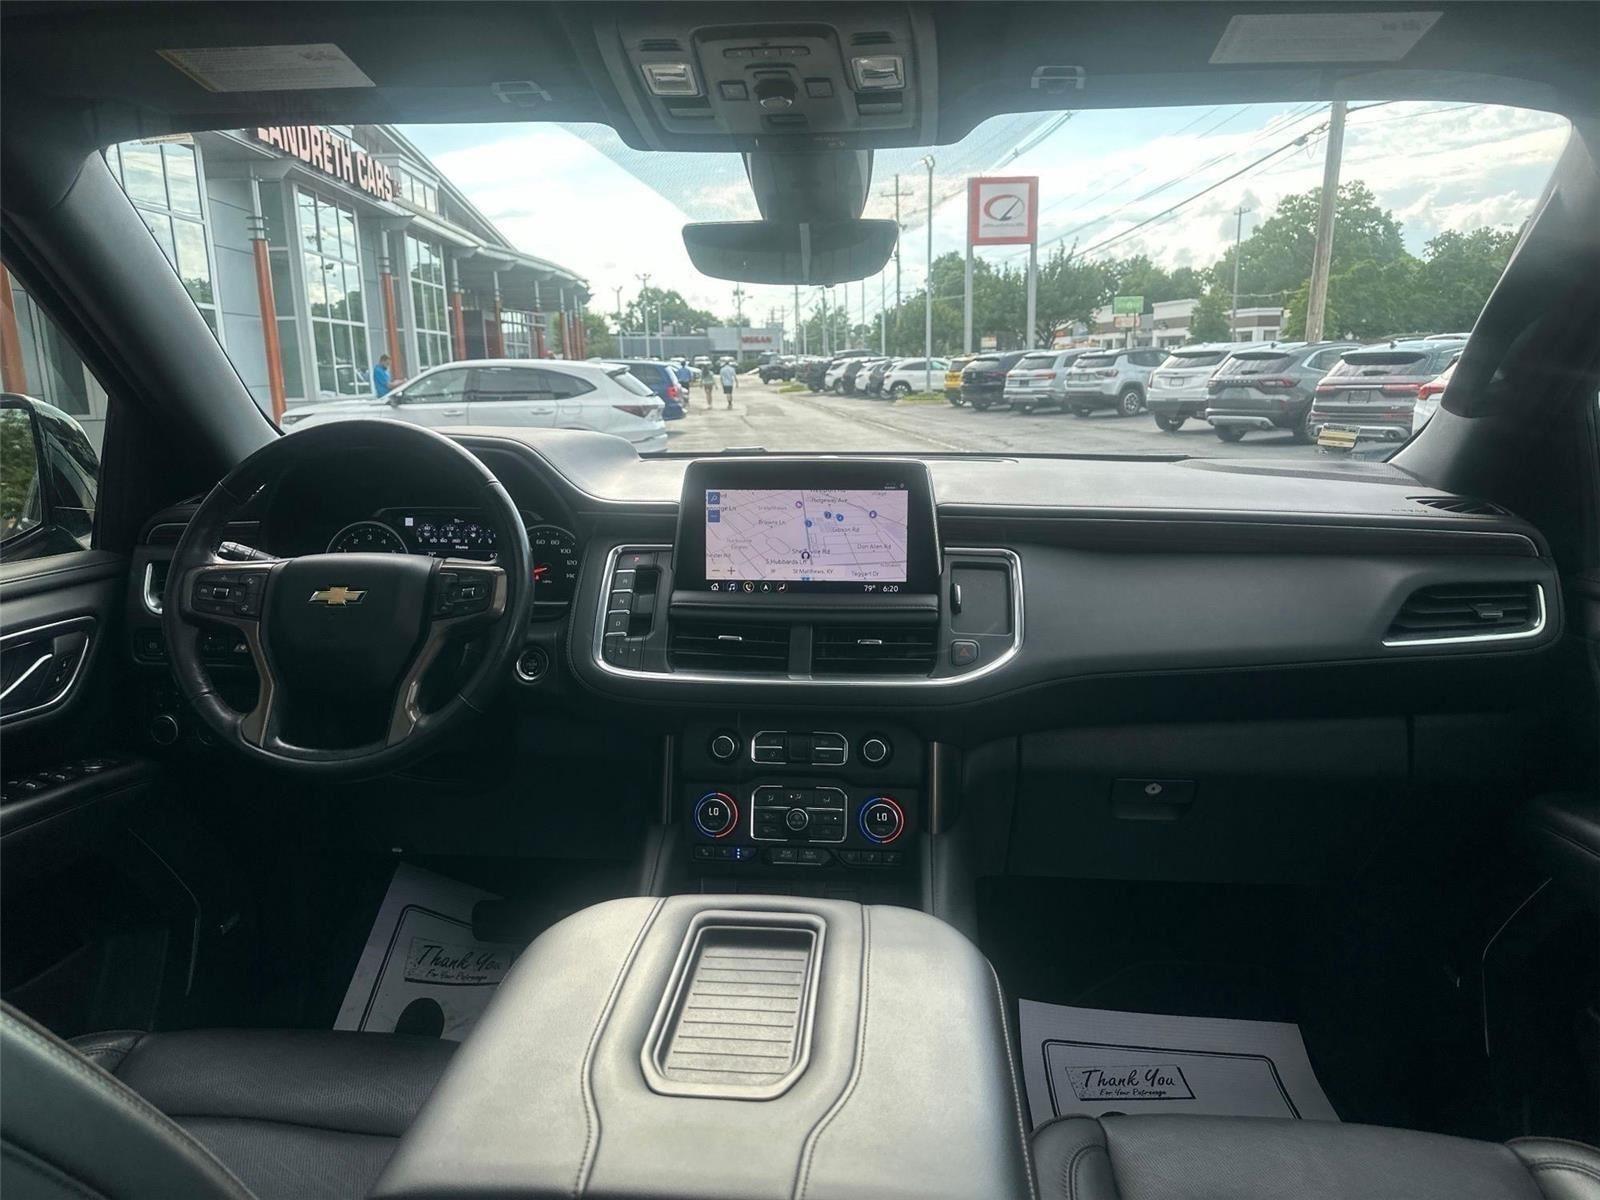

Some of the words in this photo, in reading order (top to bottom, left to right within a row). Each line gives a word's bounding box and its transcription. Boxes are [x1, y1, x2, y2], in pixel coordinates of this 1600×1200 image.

[356, 151, 393, 202] CARS
[863, 584, 876, 592] 79°
[882, 585, 899, 593] 6:20
[708, 807, 719, 816] LO
[876, 813, 888, 822] LO
[417, 944, 474, 970] Thank
[1081, 1069, 1140, 1088] Thank
[1144, 1068, 1175, 1087] You
[1100, 1088, 1112, 1096] For
[1114, 1088, 1130, 1096] Your
[1132, 1088, 1167, 1097] Patronage
